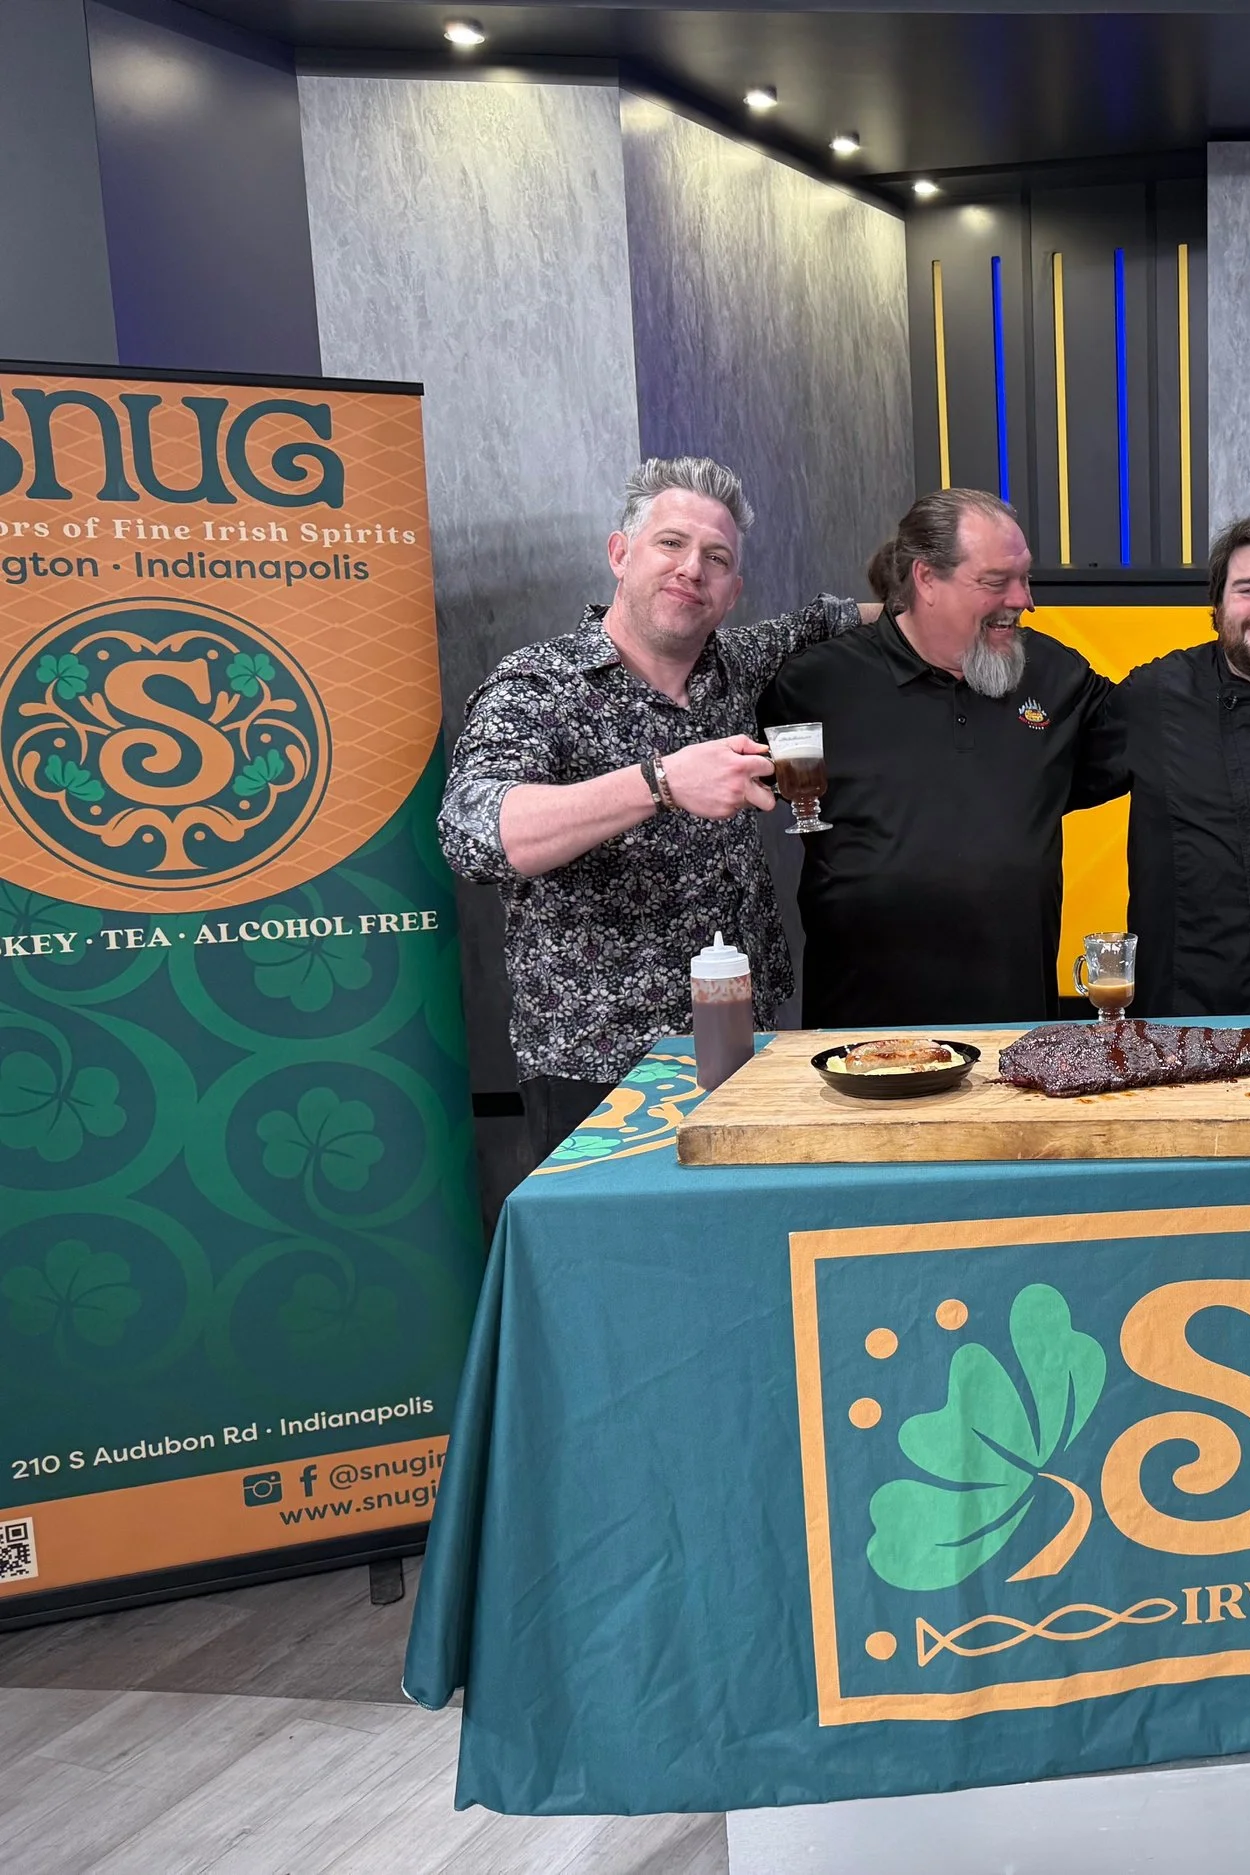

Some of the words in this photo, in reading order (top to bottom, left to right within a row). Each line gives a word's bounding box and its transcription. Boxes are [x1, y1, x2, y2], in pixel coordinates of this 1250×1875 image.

[0, 387, 344, 508] NUG
[63, 516, 100, 539] of
[113, 519, 191, 541] Fine
[203, 520, 289, 543] Irish
[300, 522, 416, 547] Spirits
[2, 551, 99, 585] gton
[135, 551, 370, 586] Indianapolis
[0, 932, 78, 957] KEY
[100, 927, 172, 951] TEA
[194, 915, 353, 945] ALCOHOL
[358, 910, 439, 934] FREE
[11, 1455, 61, 1480] 210
[69, 1451, 86, 1471] S
[93, 1434, 215, 1466] Audubon
[223, 1421, 258, 1445] Rd
[280, 1396, 434, 1437] Indianapolis
